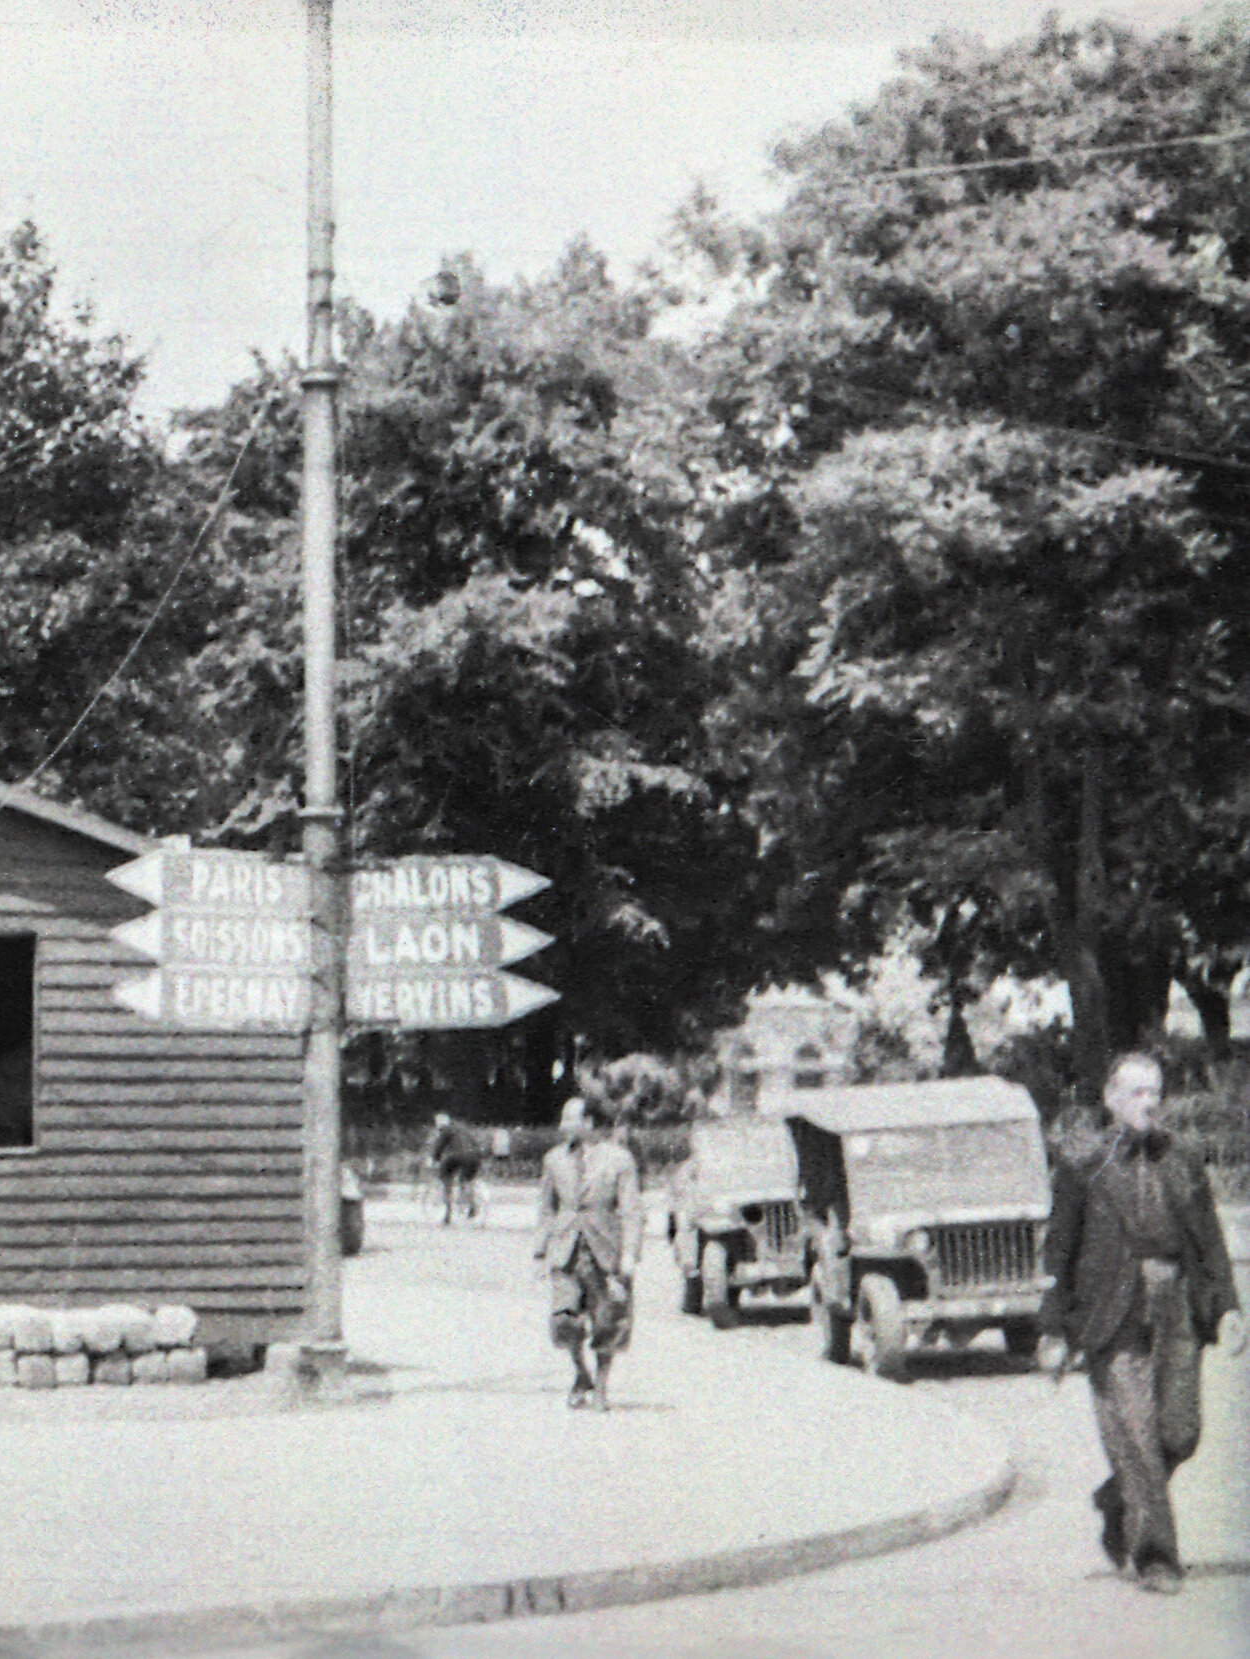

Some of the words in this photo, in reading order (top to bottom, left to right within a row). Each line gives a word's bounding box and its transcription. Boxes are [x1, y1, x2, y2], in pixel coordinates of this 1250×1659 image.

[191, 860, 283, 905] PARIS
[172, 917, 304, 964] SOISSONS
[366, 922, 481, 965] LAON
[174, 974, 300, 1020] EPERNAY
